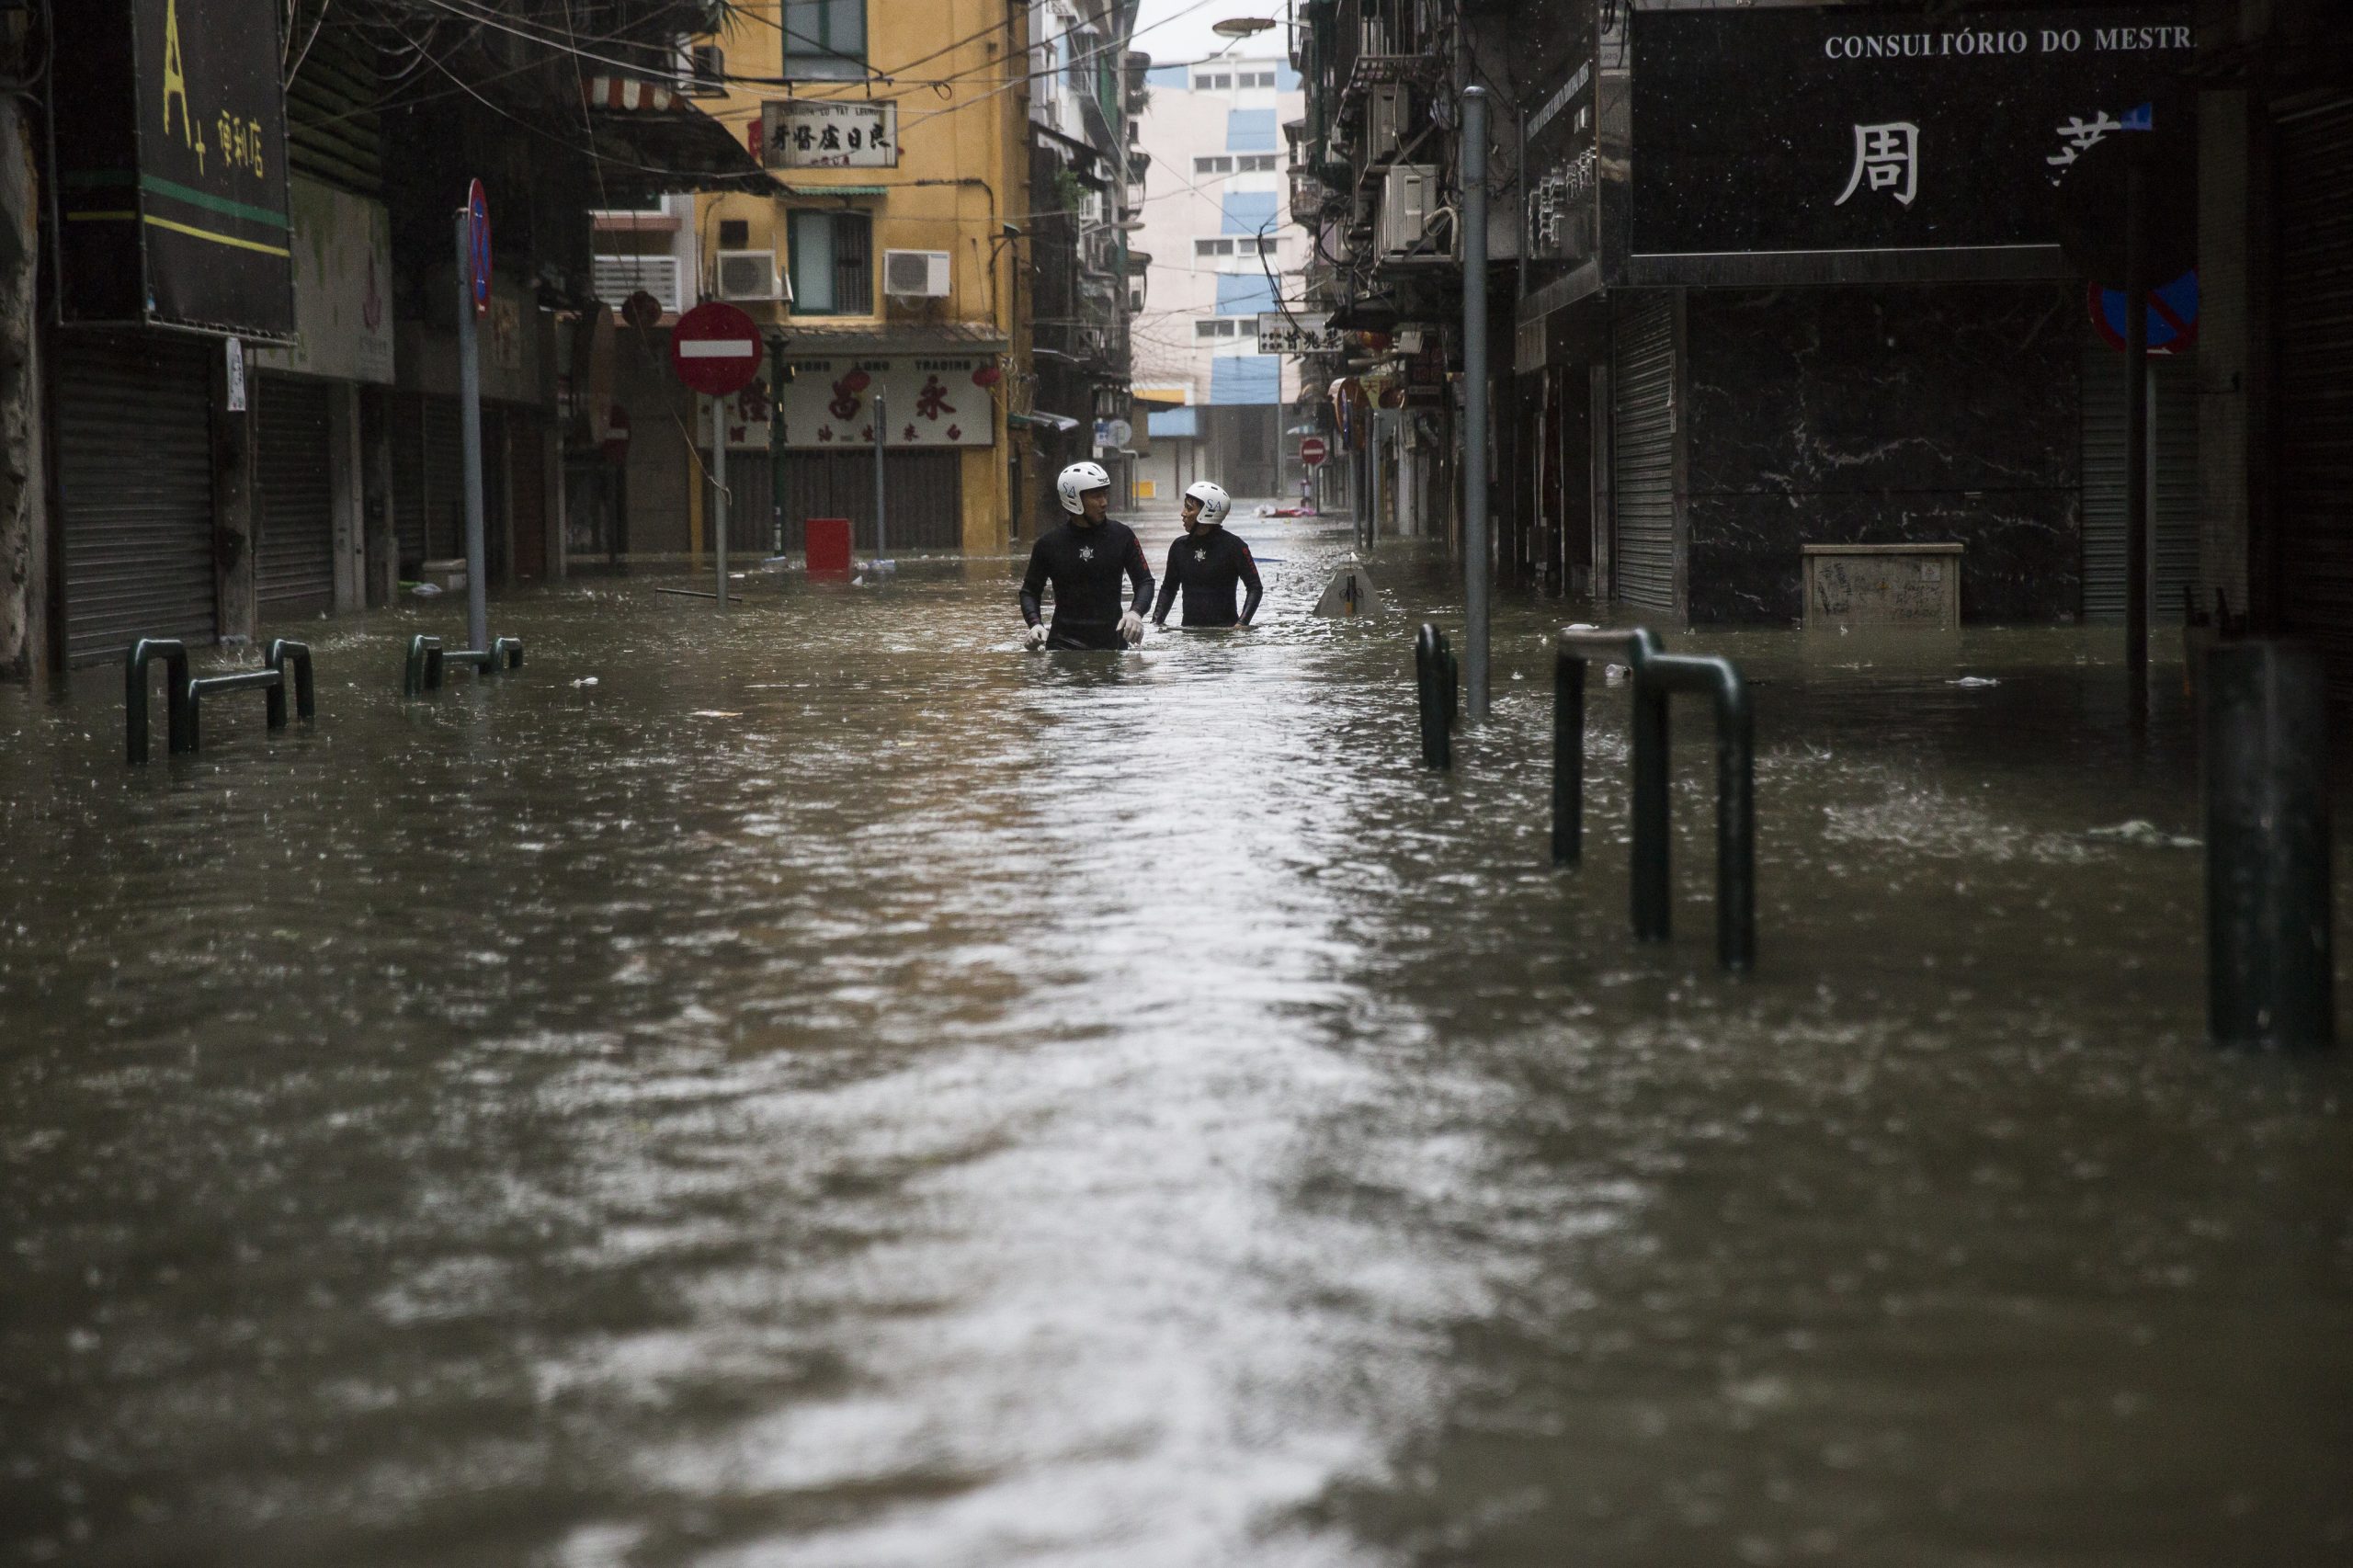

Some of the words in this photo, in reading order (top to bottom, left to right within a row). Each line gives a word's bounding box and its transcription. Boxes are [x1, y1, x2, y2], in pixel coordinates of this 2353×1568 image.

[1824, 28, 2028, 60] CONSULTÓRIO
[2041, 28, 2081, 53] DO
[2095, 25, 2197, 51] MESTR
[217, 108, 263, 179] 便利店
[915, 360, 972, 370] TRADING
[1063, 482, 1076, 496] SA
[1206, 498, 1222, 511] SA
